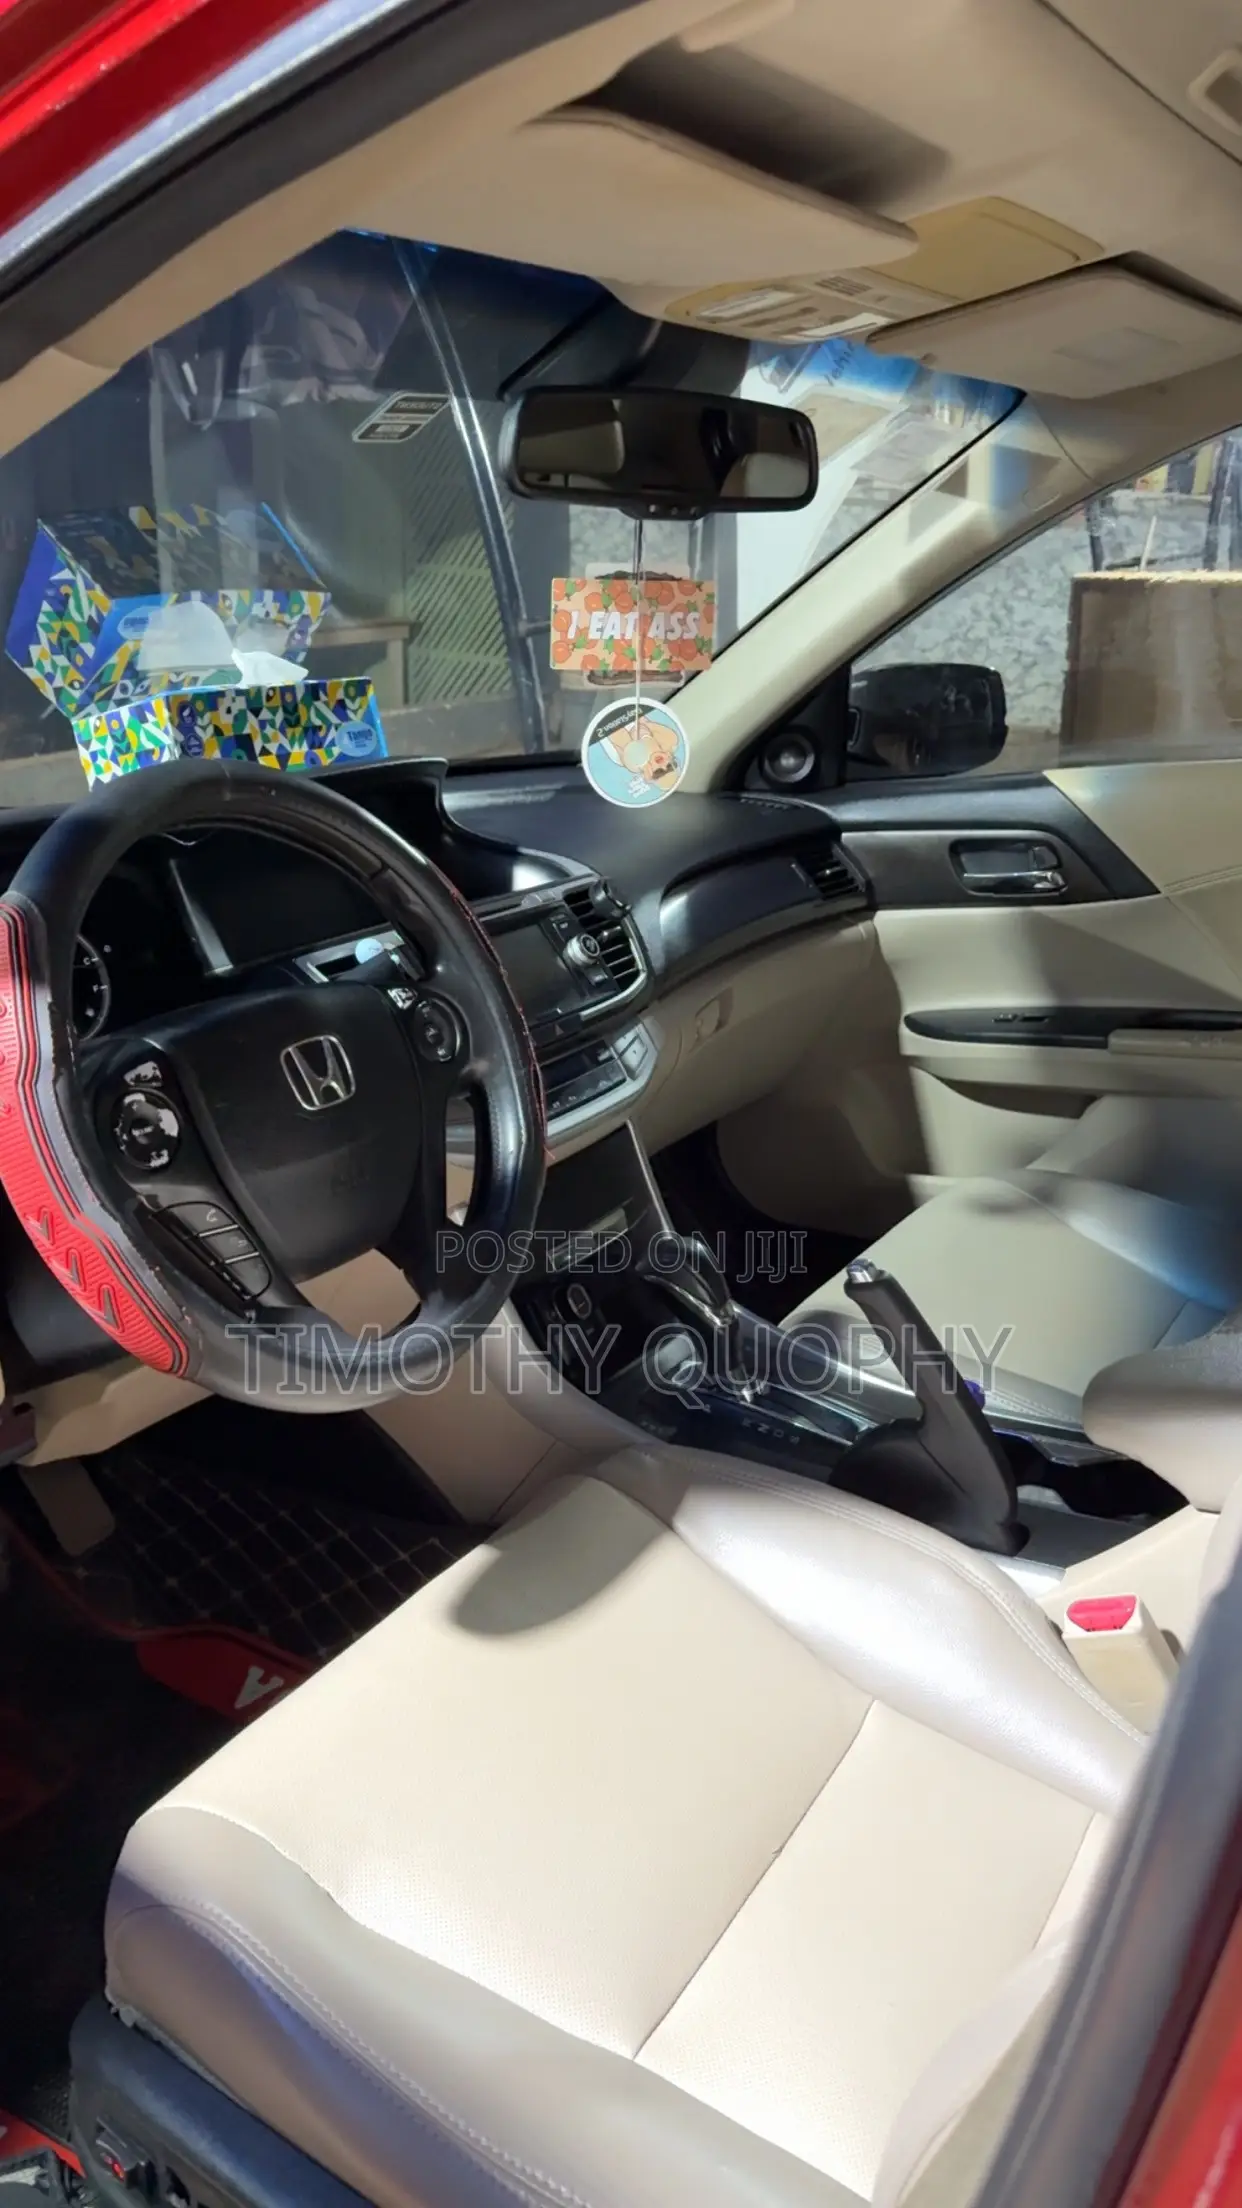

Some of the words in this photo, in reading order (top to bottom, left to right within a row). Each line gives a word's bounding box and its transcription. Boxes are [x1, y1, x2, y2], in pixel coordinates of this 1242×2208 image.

[567, 611, 580, 639] I
[588, 611, 640, 640] EAT
[647, 611, 701, 640] ASS
